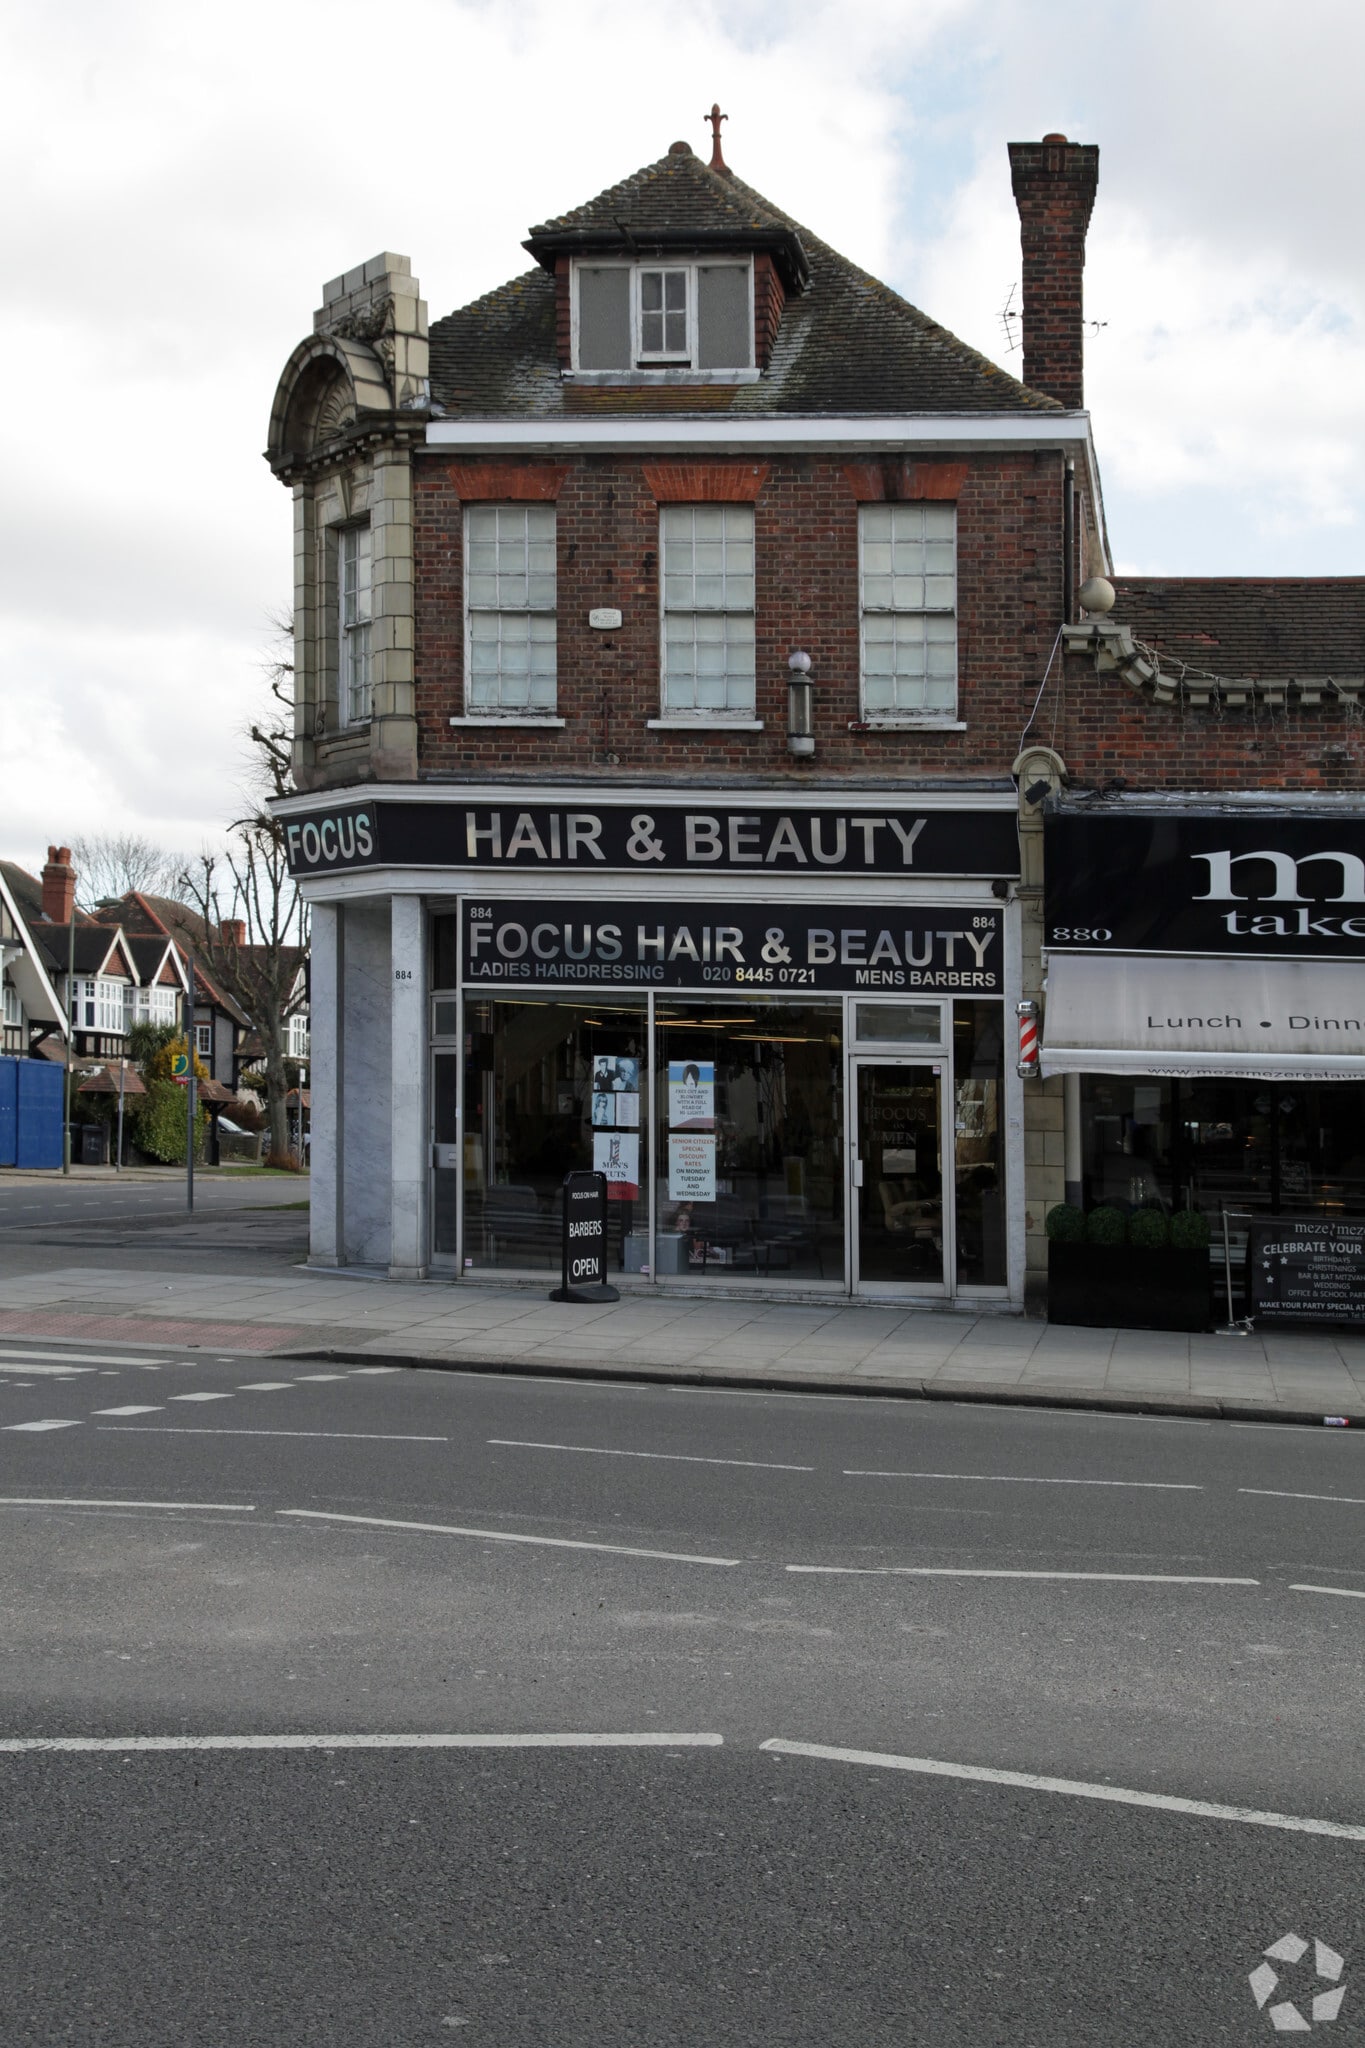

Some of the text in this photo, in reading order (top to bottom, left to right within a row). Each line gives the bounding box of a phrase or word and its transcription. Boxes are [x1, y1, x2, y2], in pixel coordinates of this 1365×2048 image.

[287, 813, 373, 865] FOCUS
[465, 812, 927, 865] HAIR & BEAUTY
[470, 907, 493, 919] 884
[972, 916, 996, 929] 884
[1052, 927, 1113, 941] 880
[470, 921, 996, 967] FOCUS HAIR & BEAUTY
[395, 969, 412, 980] 884
[470, 962, 665, 980] LADIES HAIRDRESSING
[703, 966, 816, 983] 020 8445 0721
[855, 969, 996, 987] MENS BARBERS
[1147, 1014, 1242, 1029] Lunch
[873, 1107, 926, 1121] FOCUS
[882, 1131, 918, 1145] MEN
[602, 1161, 628, 1169] MEN'S
[569, 1220, 602, 1237] BARBERS
[1295, 1223, 1365, 1235] meze mez
[1263, 1241, 1362, 1255] CELEBRATE YOUR
[1313, 1255, 1351, 1264] BIRTHDAYS
[572, 1257, 599, 1277] OPEN
[1307, 1264, 1357, 1273] CHRISTENINGS
[1313, 1281, 1351, 1290] WEDDINGS
[1287, 1289, 1311, 1297] OFFICE
[1320, 1290, 1348, 1298] SCHOOL
[1259, 1301, 1280, 1309] MAKE
[1326, 1302, 1354, 1311] SPECIAL
